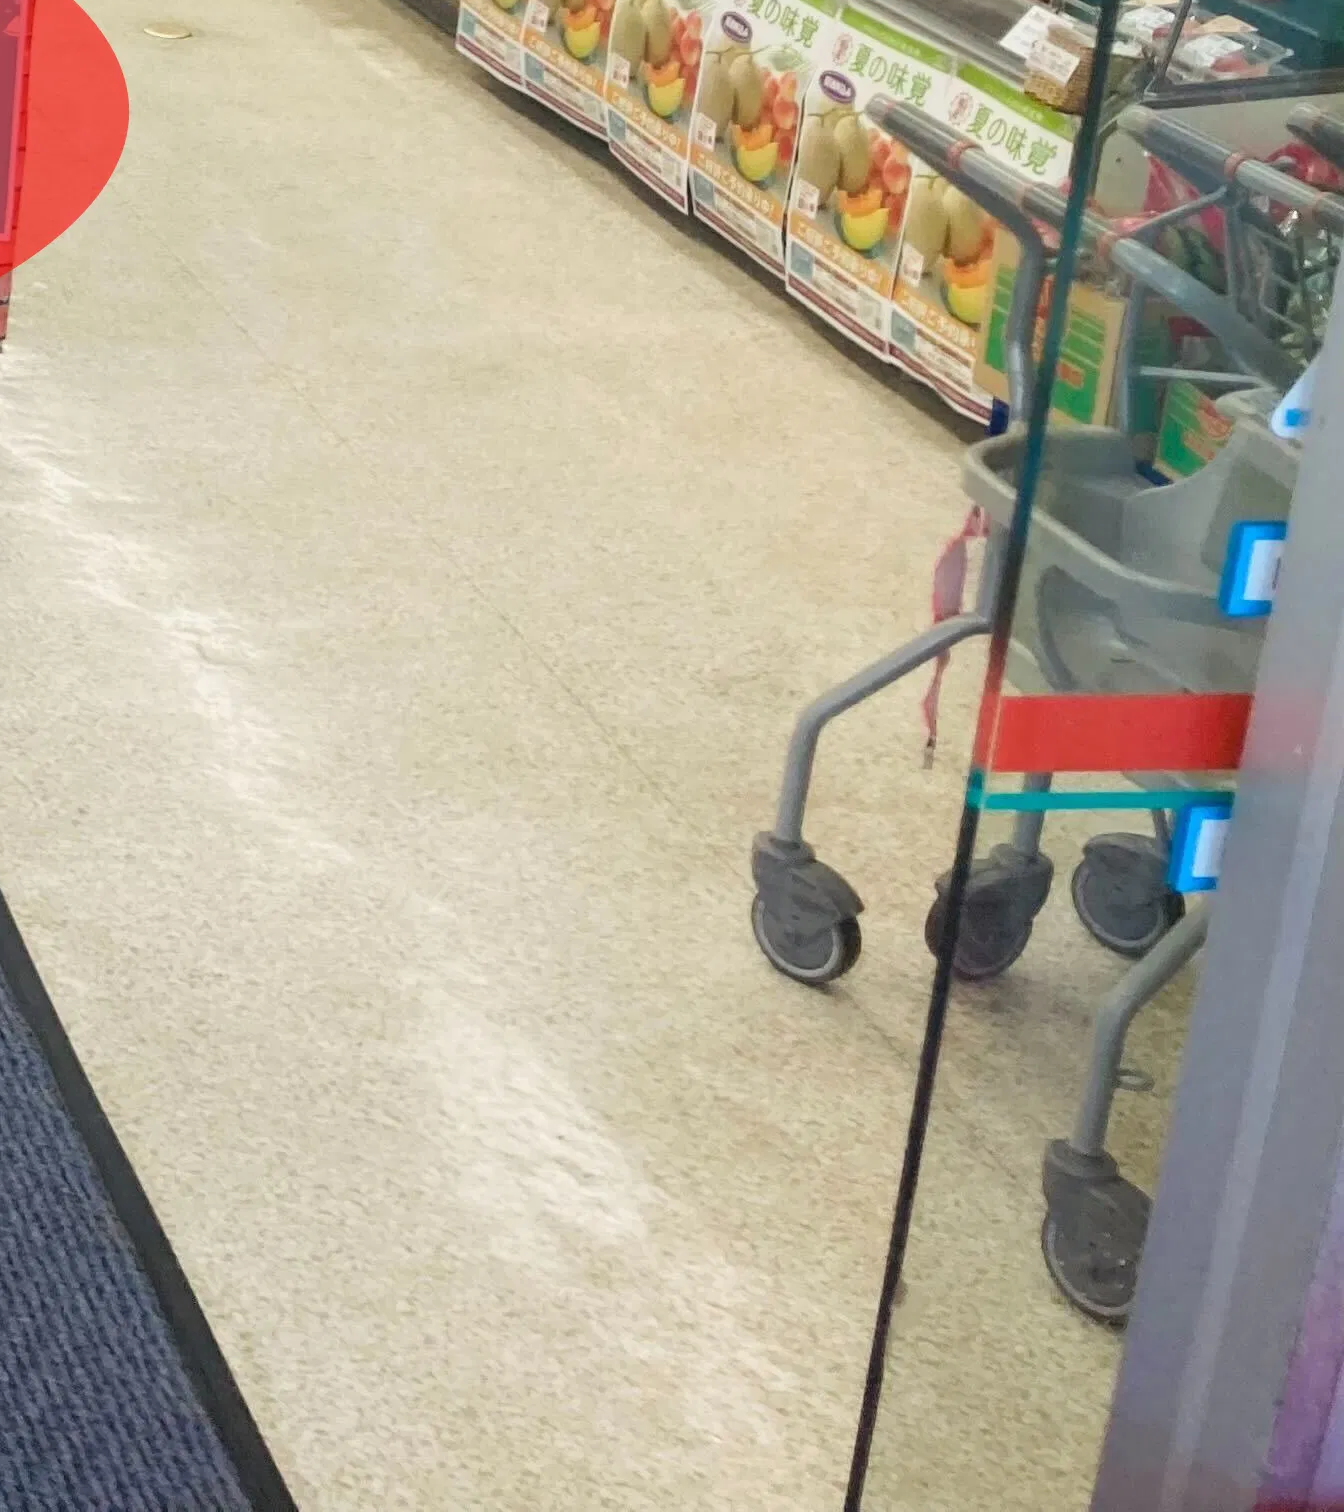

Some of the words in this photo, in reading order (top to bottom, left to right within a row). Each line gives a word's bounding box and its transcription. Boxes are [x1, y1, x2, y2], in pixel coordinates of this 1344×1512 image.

[849, 42, 934, 107] 夏の味覚
[968, 107, 1059, 175] 夏の味覚
